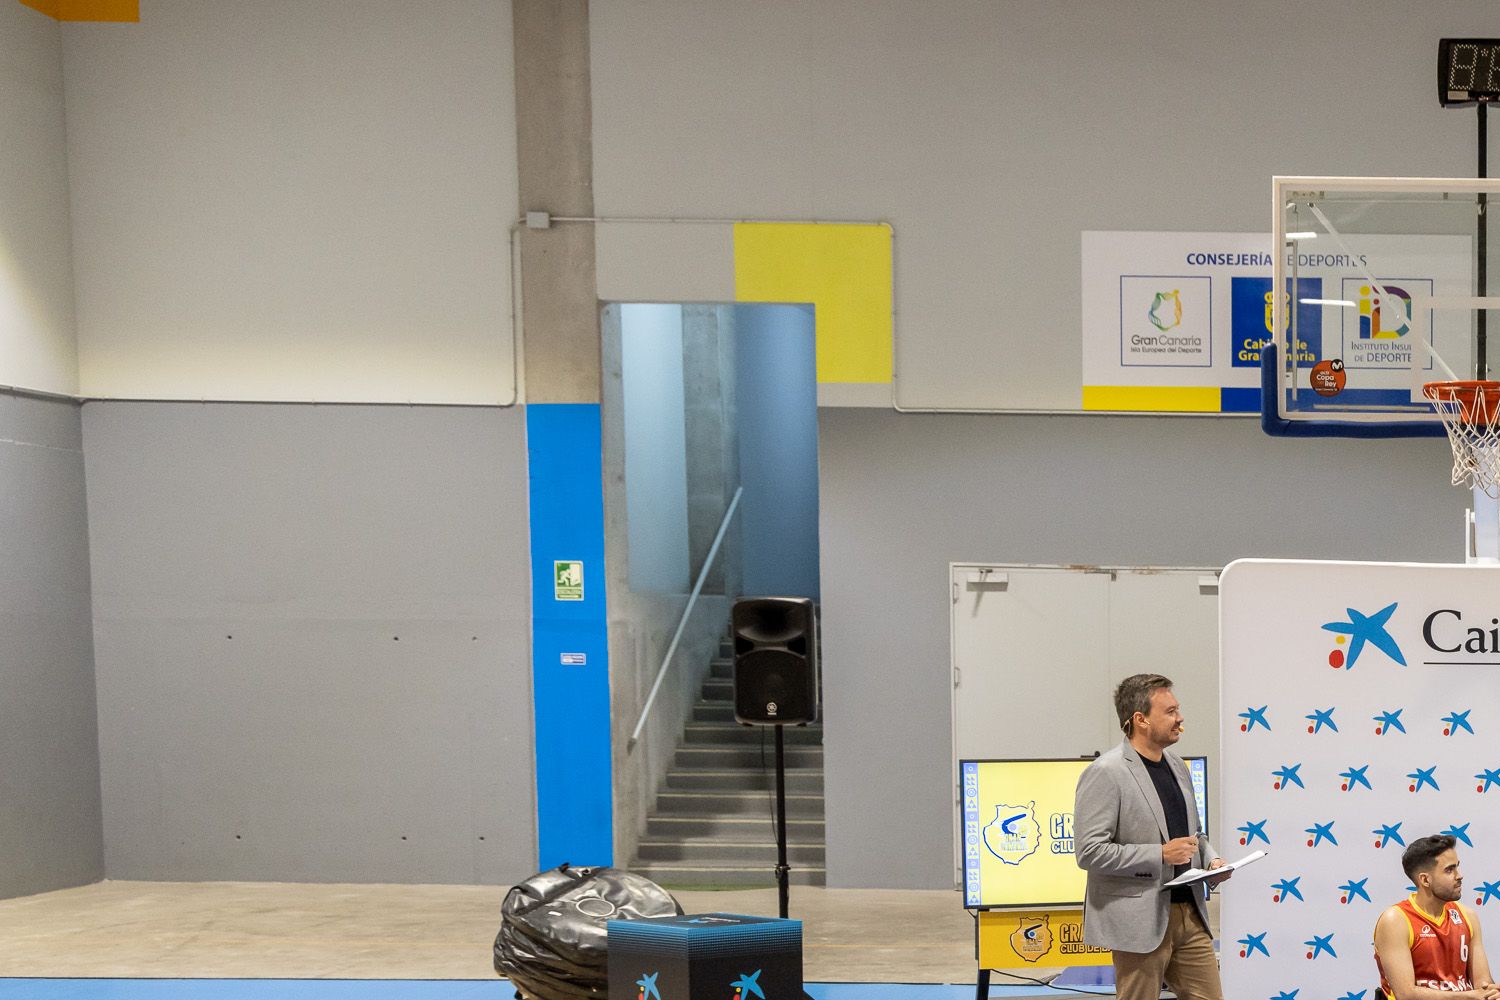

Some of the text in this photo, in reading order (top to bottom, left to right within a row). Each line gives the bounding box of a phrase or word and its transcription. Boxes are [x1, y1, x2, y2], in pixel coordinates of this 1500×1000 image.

[1187, 252, 1273, 266] CONSEJERÍA
[1238, 350, 1260, 361] Gra
[1050, 812, 1075, 840] GR
[1060, 943, 1085, 954] CLUB
[1460, 934, 1469, 962] 6
